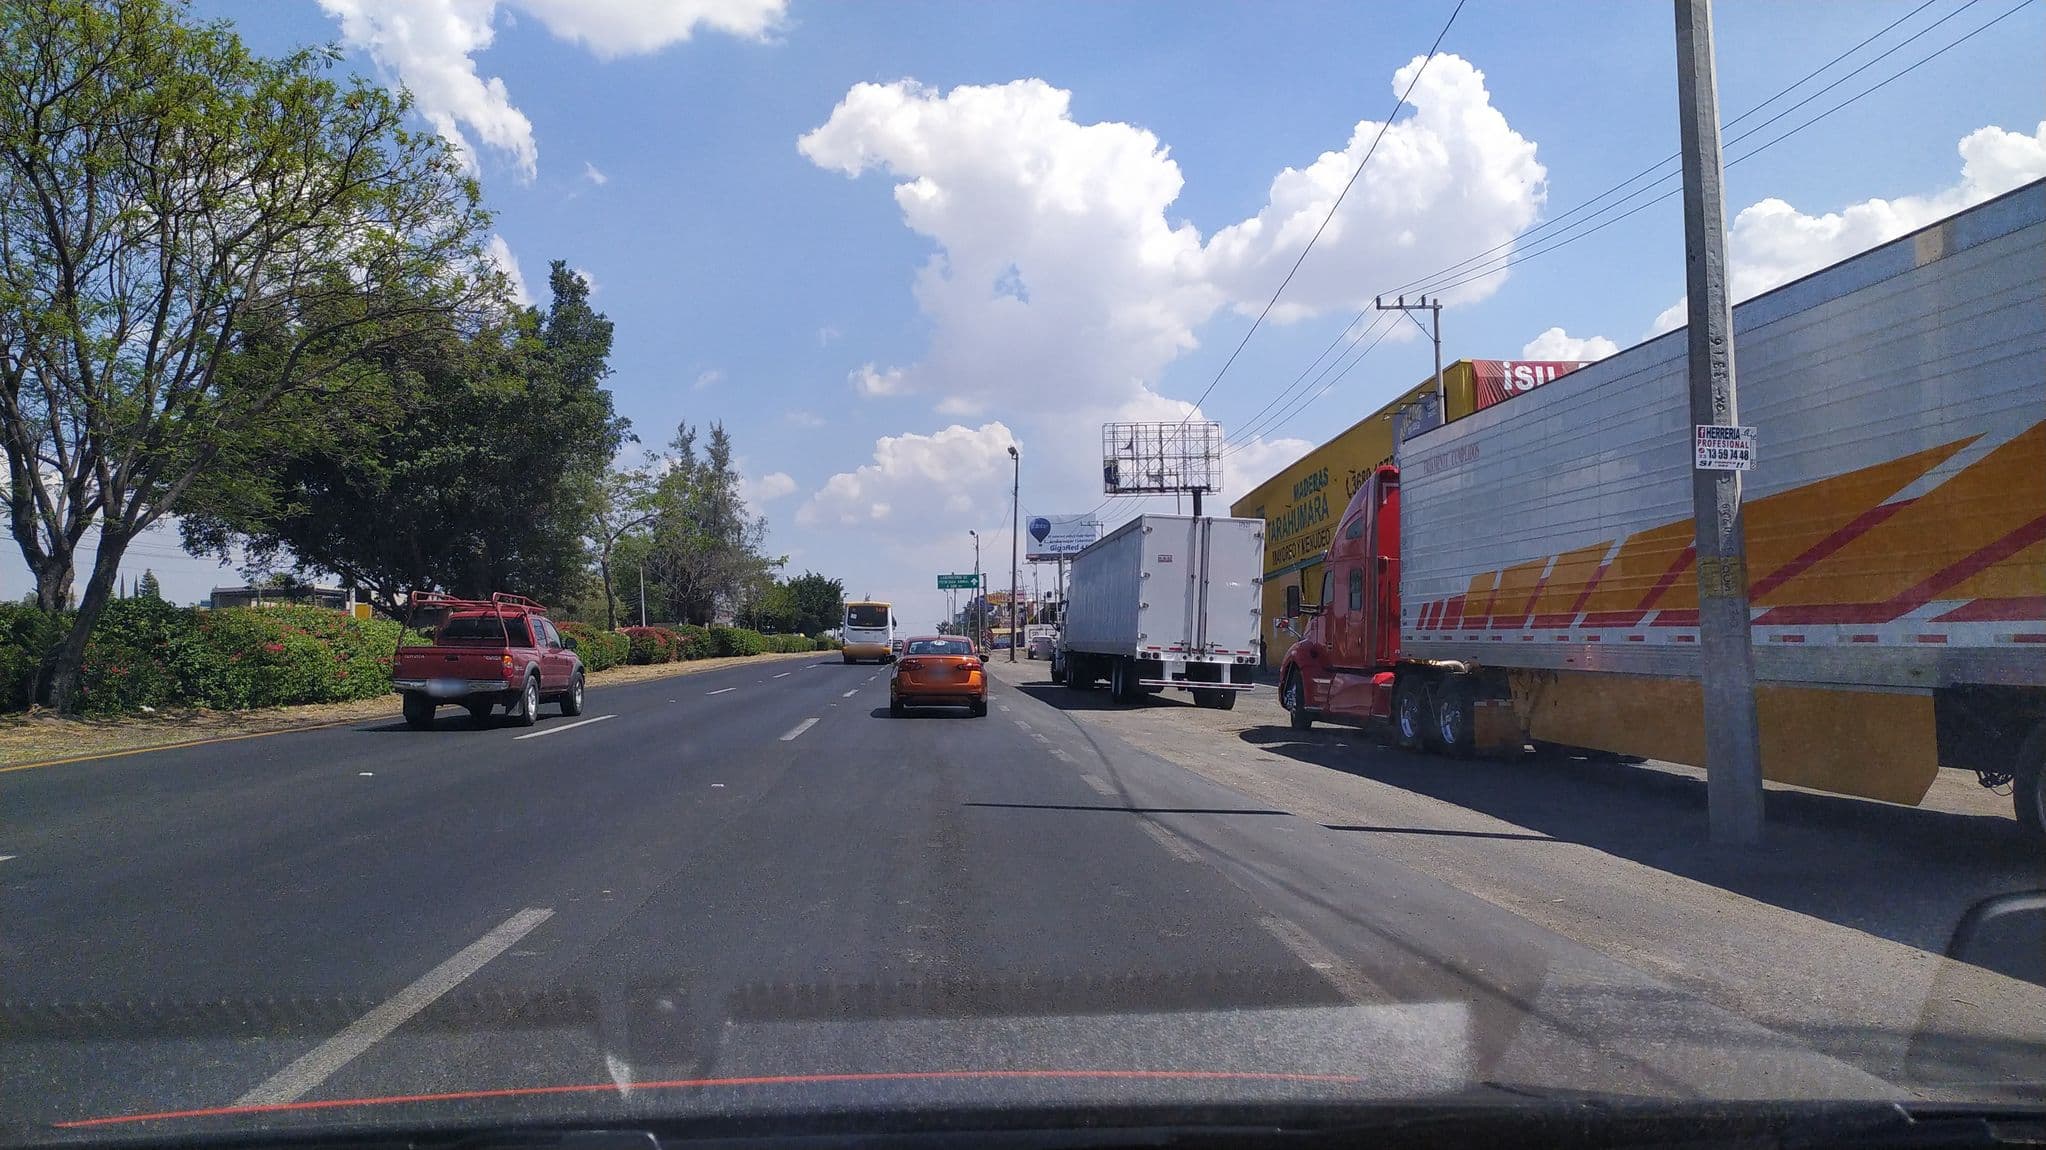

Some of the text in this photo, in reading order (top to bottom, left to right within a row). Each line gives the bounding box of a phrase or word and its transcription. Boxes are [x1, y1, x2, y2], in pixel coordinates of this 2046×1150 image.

[1698, 439, 1749, 449] PROFESIONAL
[1706, 427, 1740, 440] HERRERIA
[1293, 467, 1329, 502] MADERAS
[1267, 492, 1330, 545] TARAHUMARA
[1301, 528, 1331, 555] MENUDEO
